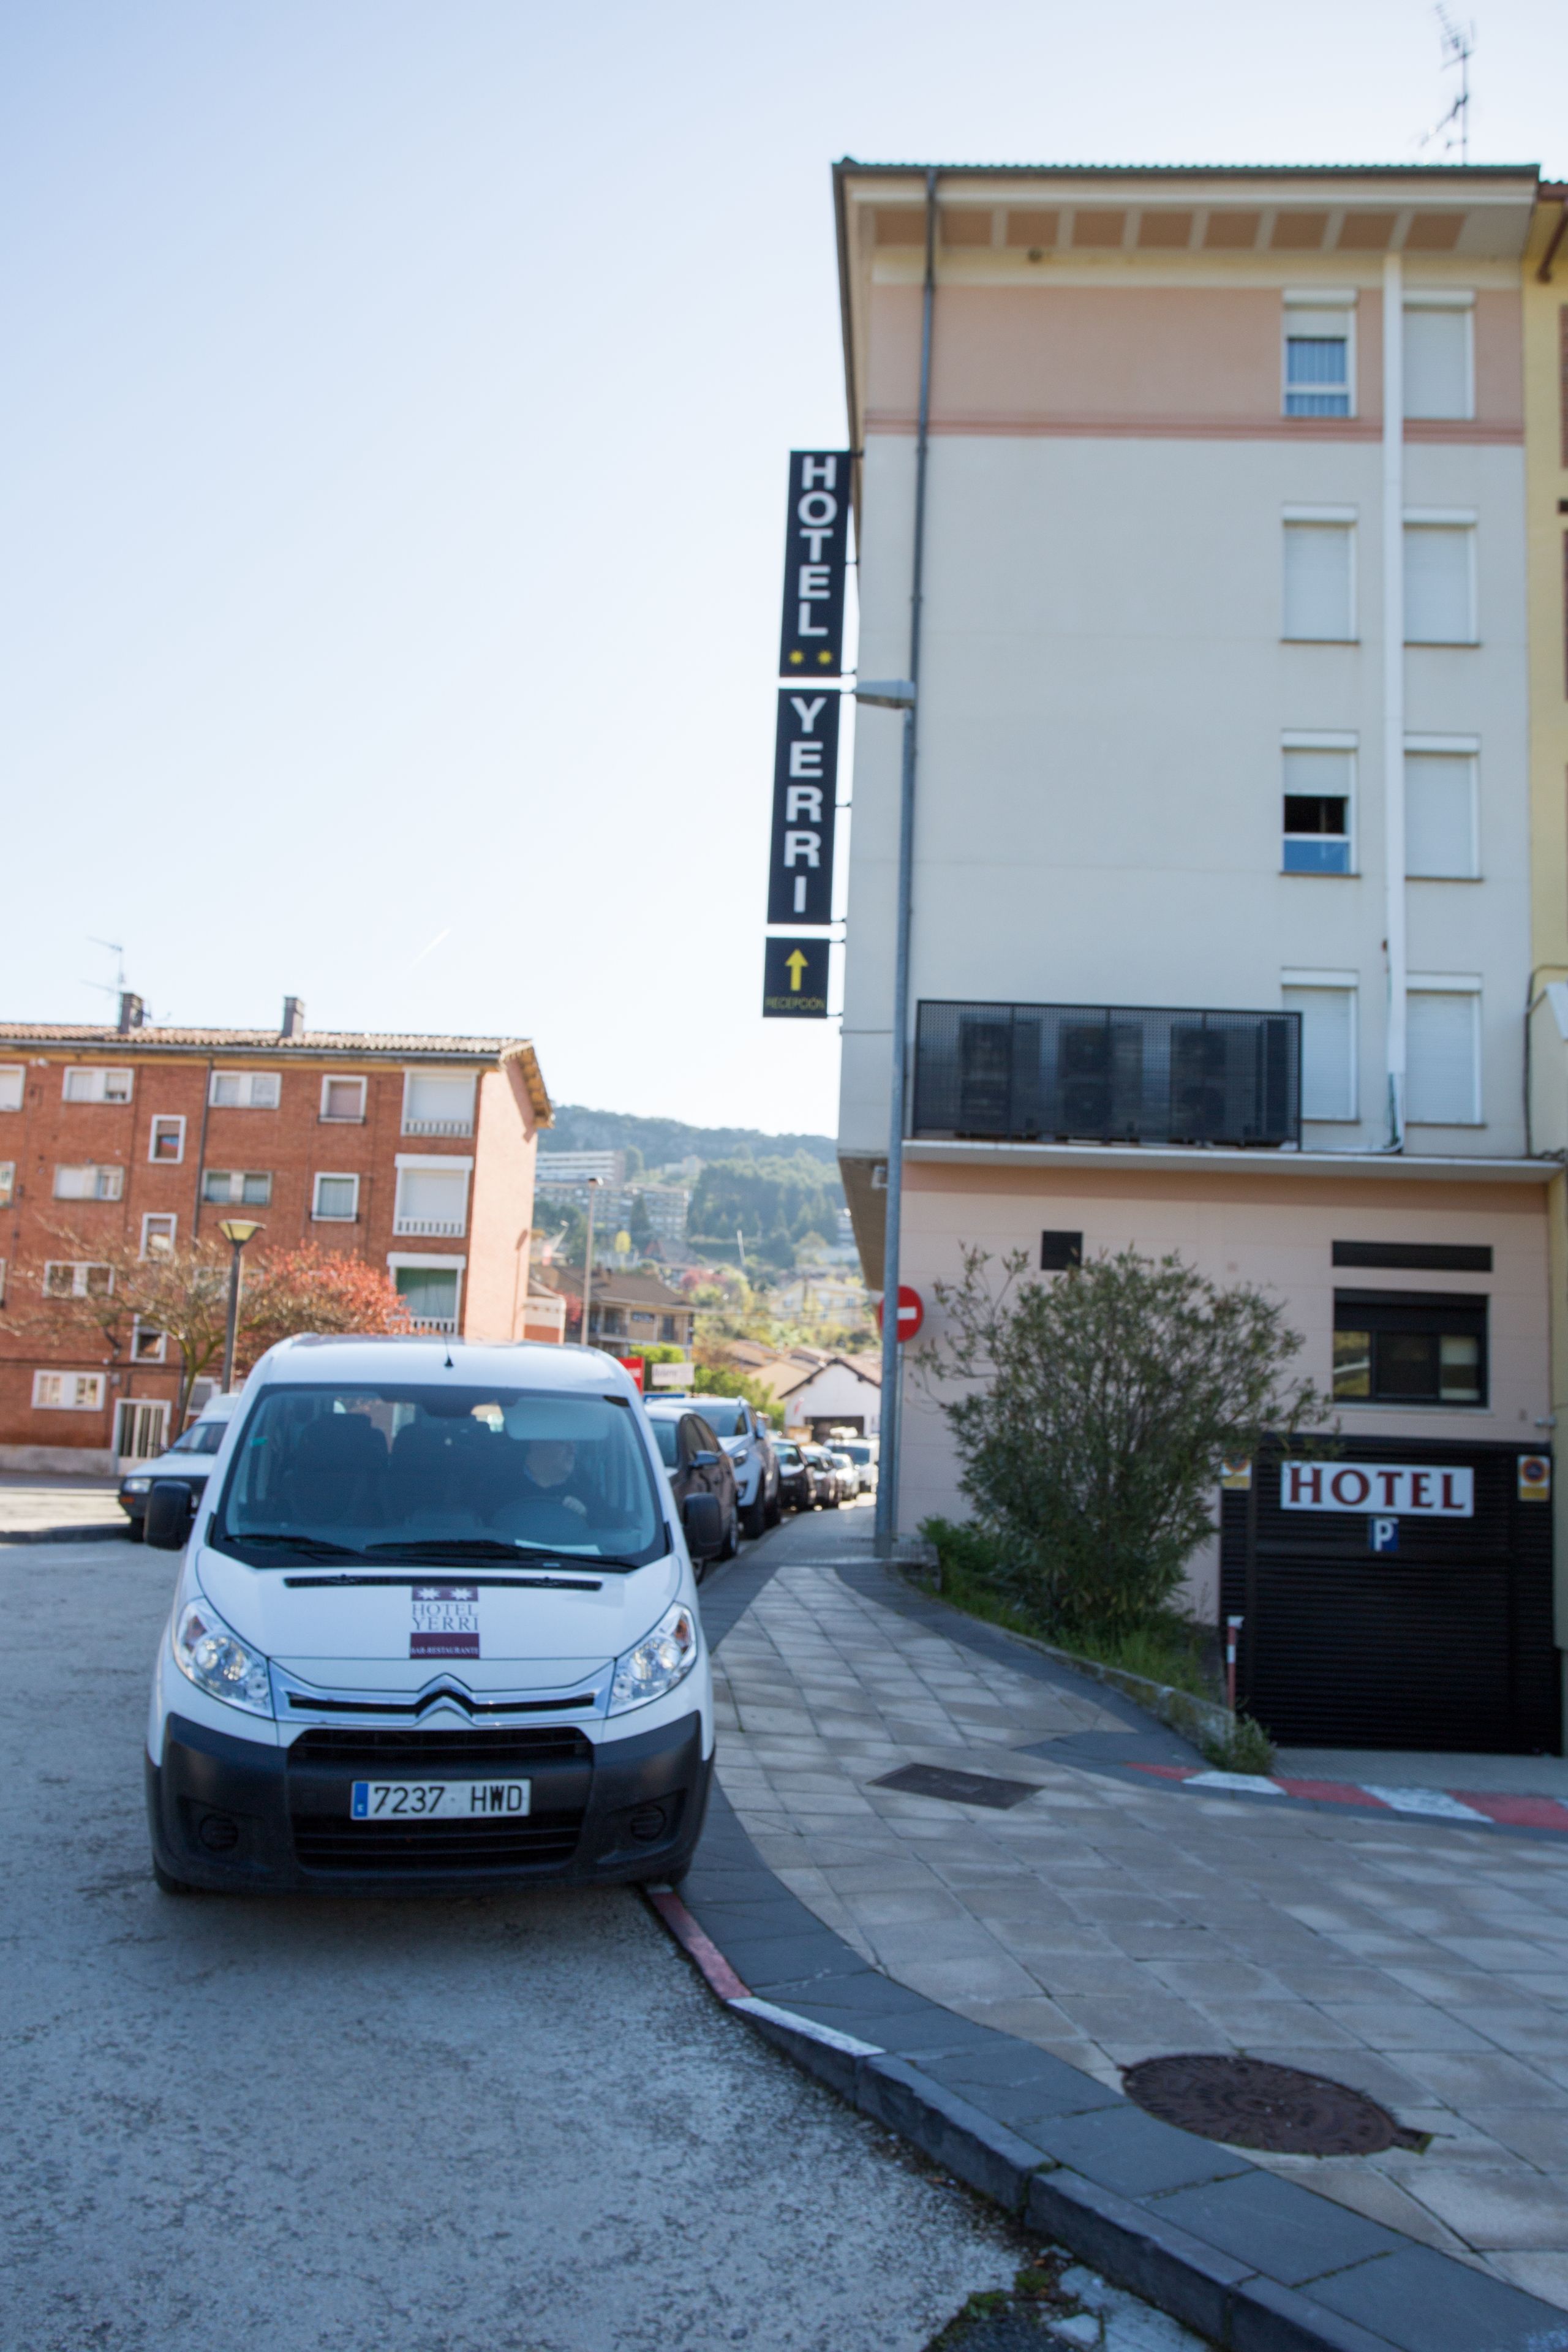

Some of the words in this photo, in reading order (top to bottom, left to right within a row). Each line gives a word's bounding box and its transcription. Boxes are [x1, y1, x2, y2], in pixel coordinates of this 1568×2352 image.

[797, 456, 838, 637] HOTEL
[783, 697, 827, 913] YERRI
[1290, 1467, 1464, 1509] HOTEL
[1374, 1520, 1394, 1551] P
[412, 1604, 478, 1616] HOTEL
[412, 1616, 478, 1630] YERRI
[374, 1786, 445, 1813] 7237
[471, 1785, 522, 1812] HWD
